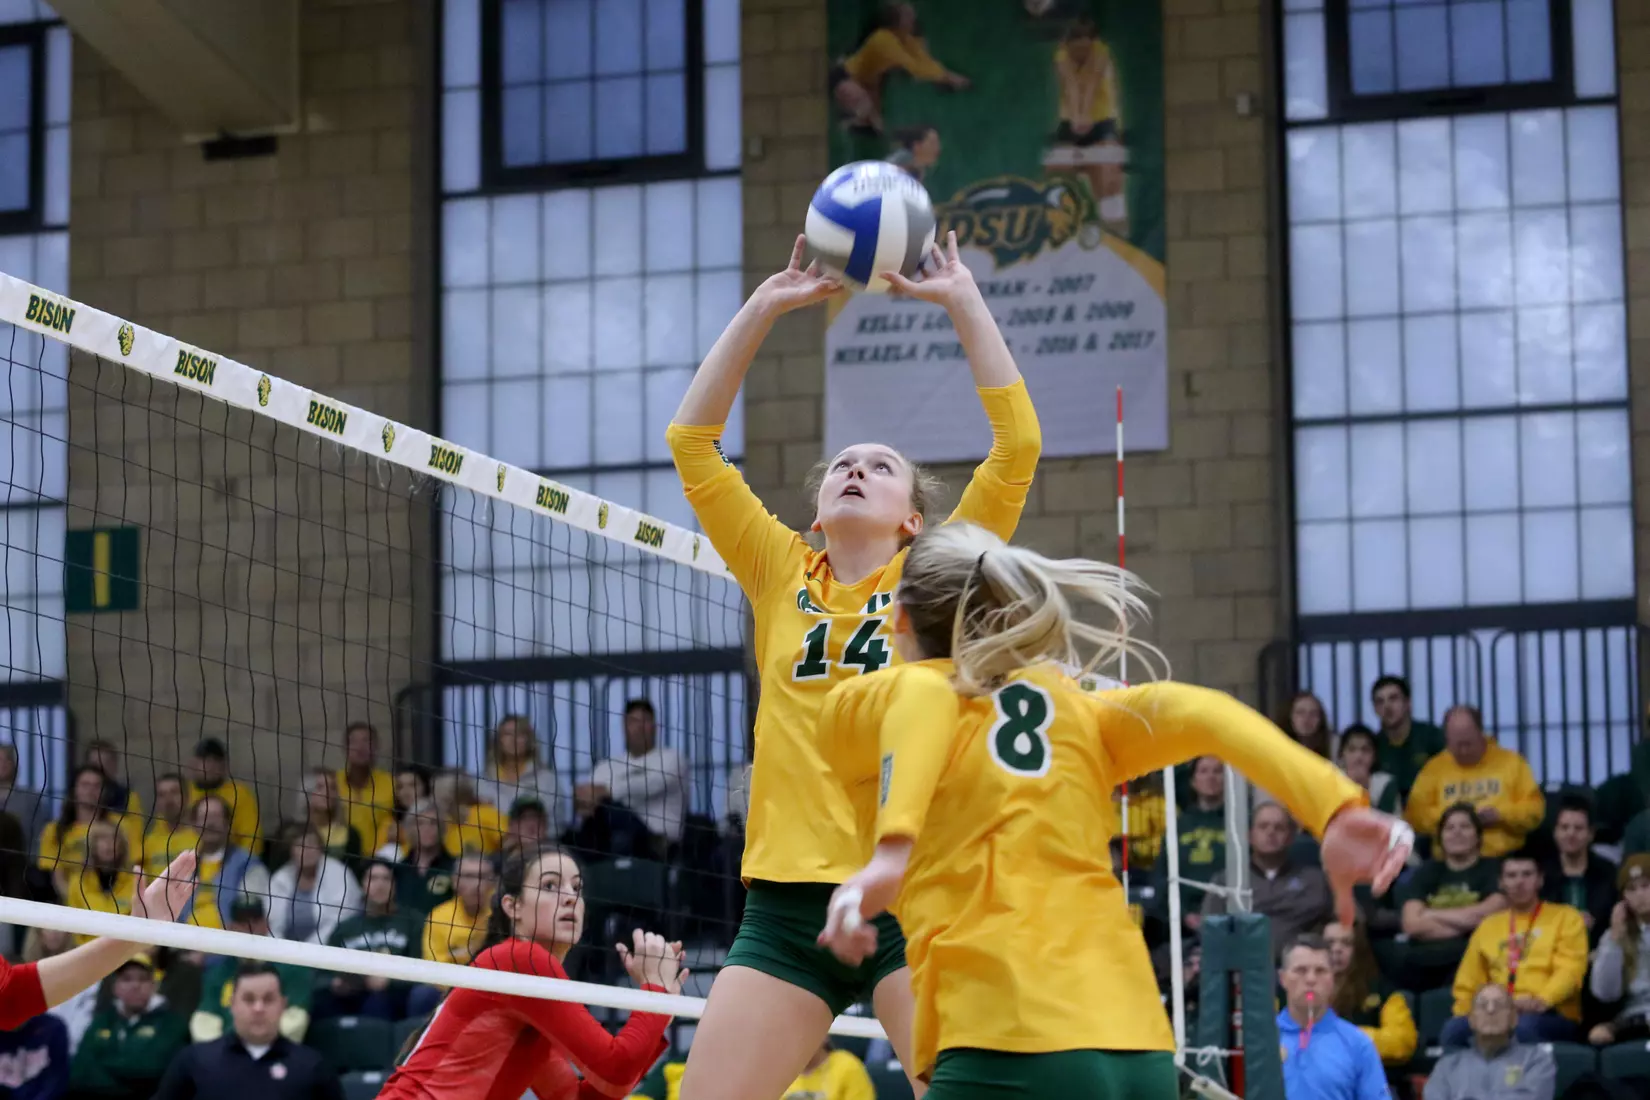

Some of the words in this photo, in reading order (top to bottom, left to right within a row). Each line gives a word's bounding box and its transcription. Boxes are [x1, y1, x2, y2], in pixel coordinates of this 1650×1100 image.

[25, 294, 76, 334] BISON
[174, 349, 217, 386] BISON
[306, 400, 347, 435] BISON
[428, 444, 464, 476] BISON
[535, 484, 570, 515] BISON
[792, 617, 893, 682] 14
[988, 680, 1054, 777] 8
